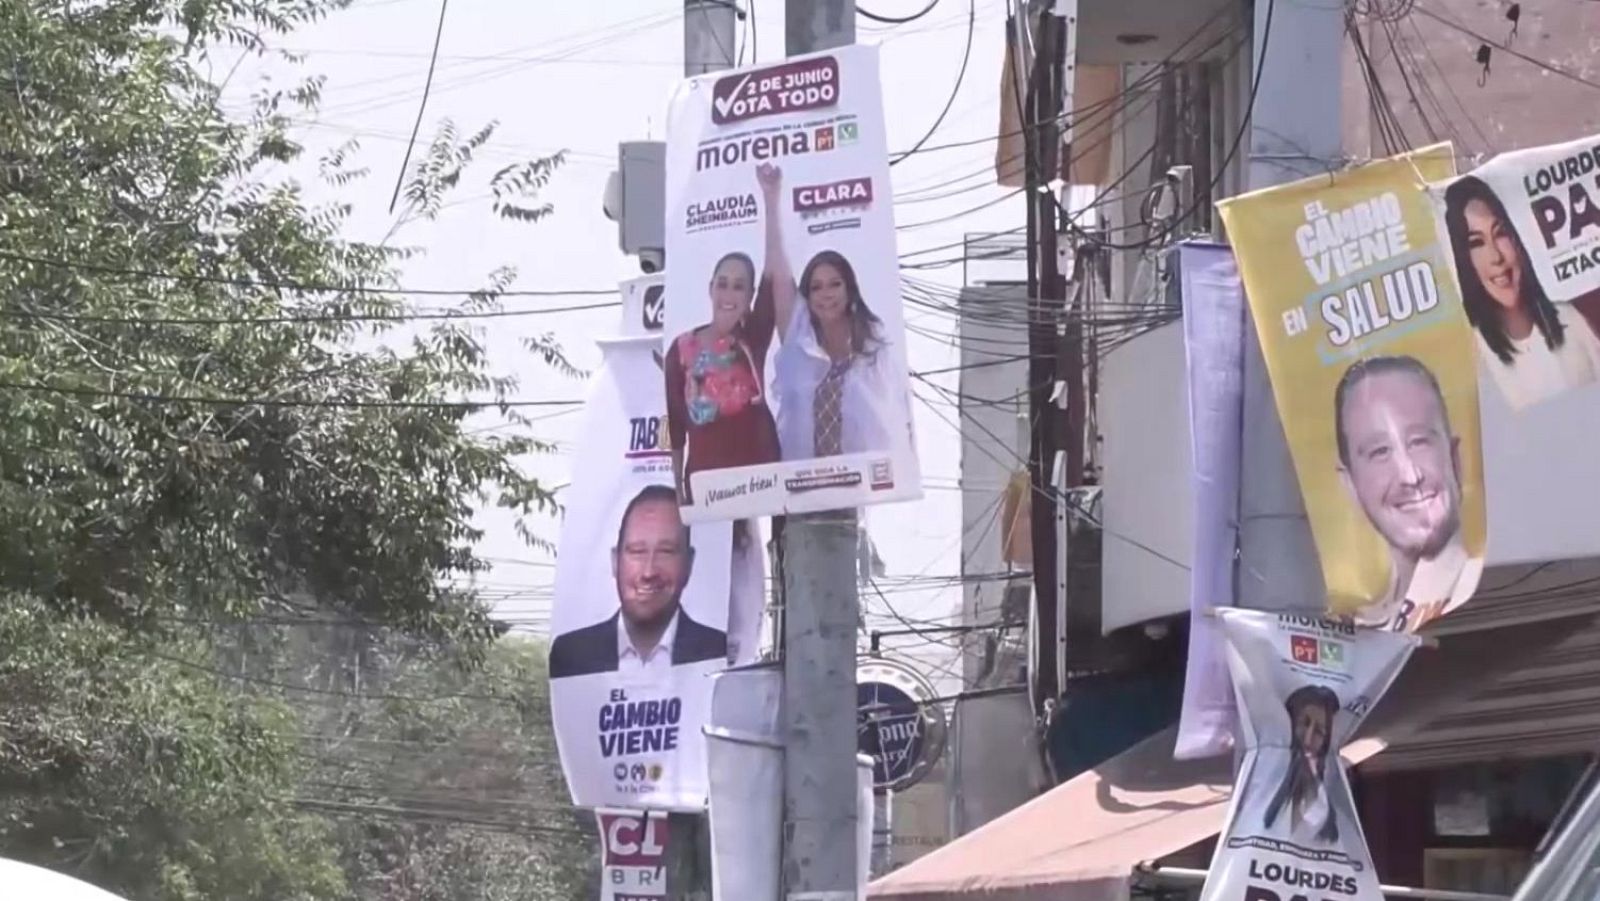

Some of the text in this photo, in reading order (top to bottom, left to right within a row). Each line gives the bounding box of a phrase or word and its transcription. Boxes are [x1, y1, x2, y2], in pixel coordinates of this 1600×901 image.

[746, 67, 833, 96] 2 DE JUNIO
[778, 84, 834, 108] TODO
[697, 131, 810, 172] morena
[686, 194, 757, 218] CLAUDIA
[799, 182, 867, 206] CLARA
[686, 207, 757, 229] SHEINBAUM
[1303, 200, 1330, 219] EL
[1530, 174, 1600, 250] PA
[1294, 191, 1403, 258] CAMBIO
[1304, 224, 1411, 287] VIENE
[1320, 260, 1439, 347] SALUD
[1281, 308, 1308, 337] EN
[1294, 645, 1316, 662] PT
[610, 689, 628, 702] EL
[599, 697, 682, 733] CAMBIO
[599, 726, 680, 758] VIENE
[1248, 859, 1358, 896] LOURDES
